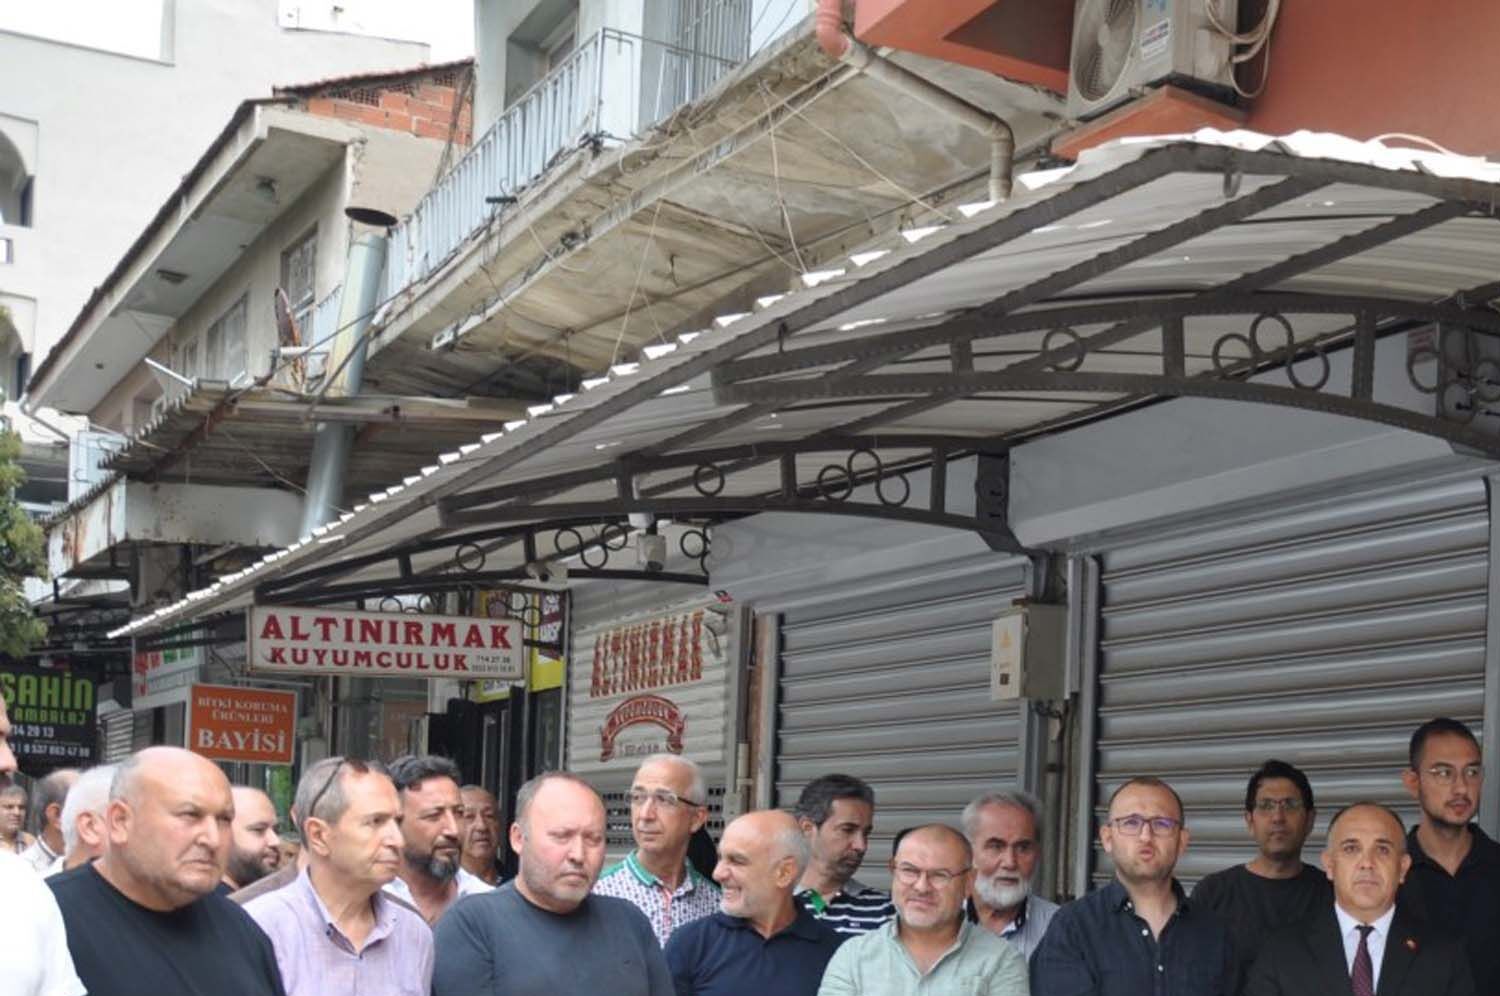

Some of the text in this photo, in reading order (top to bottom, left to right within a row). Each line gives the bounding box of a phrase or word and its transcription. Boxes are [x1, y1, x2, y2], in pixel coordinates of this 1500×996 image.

[260, 614, 512, 649] ALTINIRMAK
[270, 647, 469, 671] KUYUMCULUK
[198, 728, 286, 752] BAYİSİ
